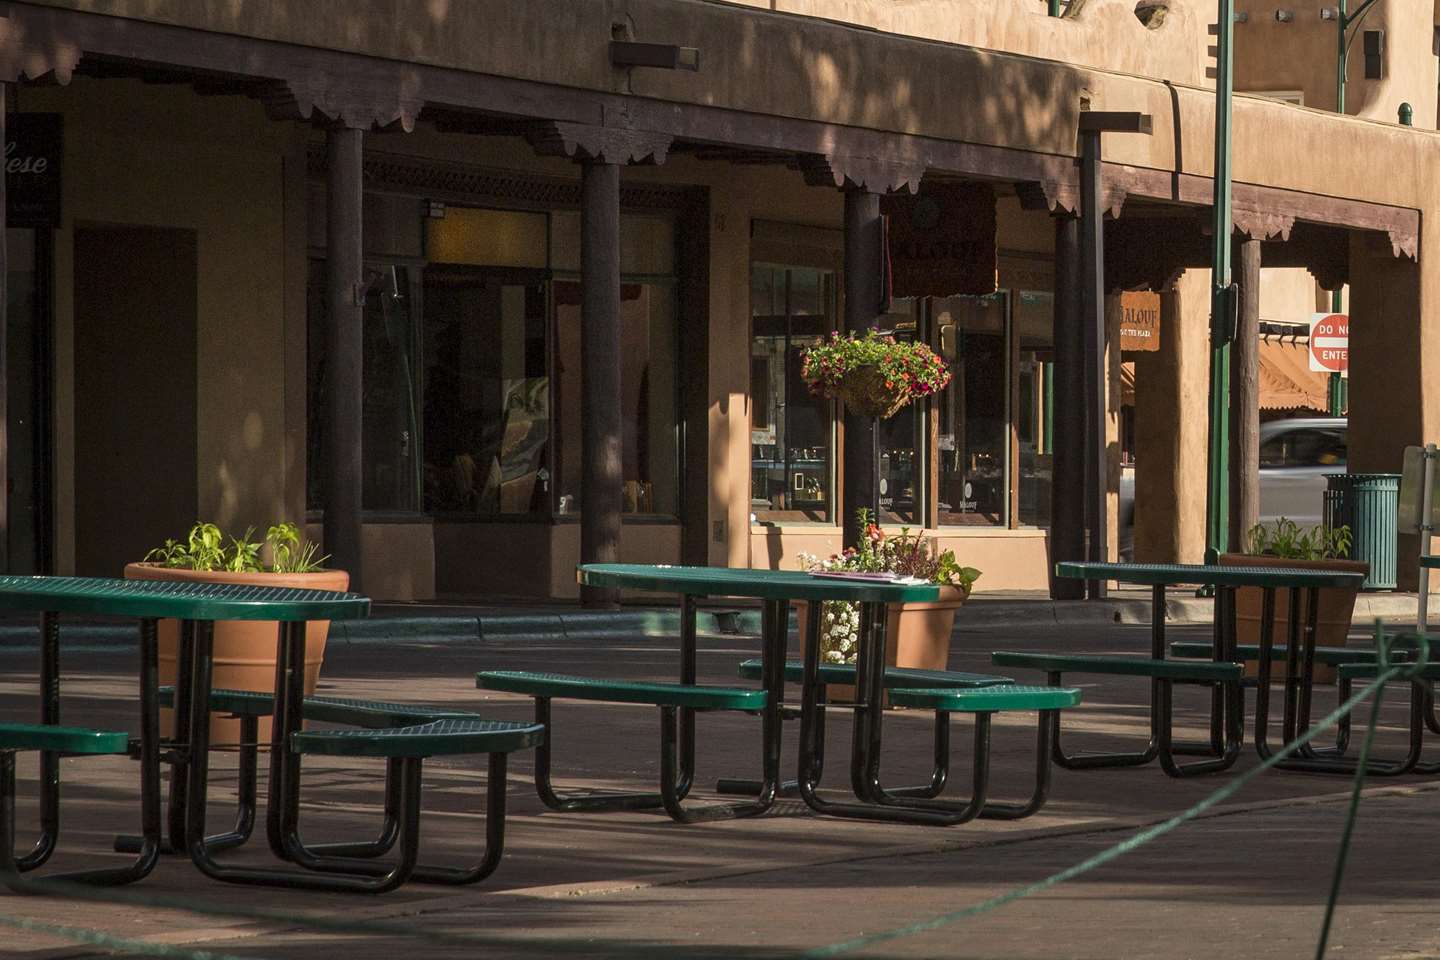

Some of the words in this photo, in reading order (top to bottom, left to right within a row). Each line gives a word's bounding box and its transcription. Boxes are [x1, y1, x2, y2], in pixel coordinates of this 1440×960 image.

[5, 142, 48, 174] ese
[1319, 325, 1334, 335] DO
[1322, 350, 1348, 360] ENTE
